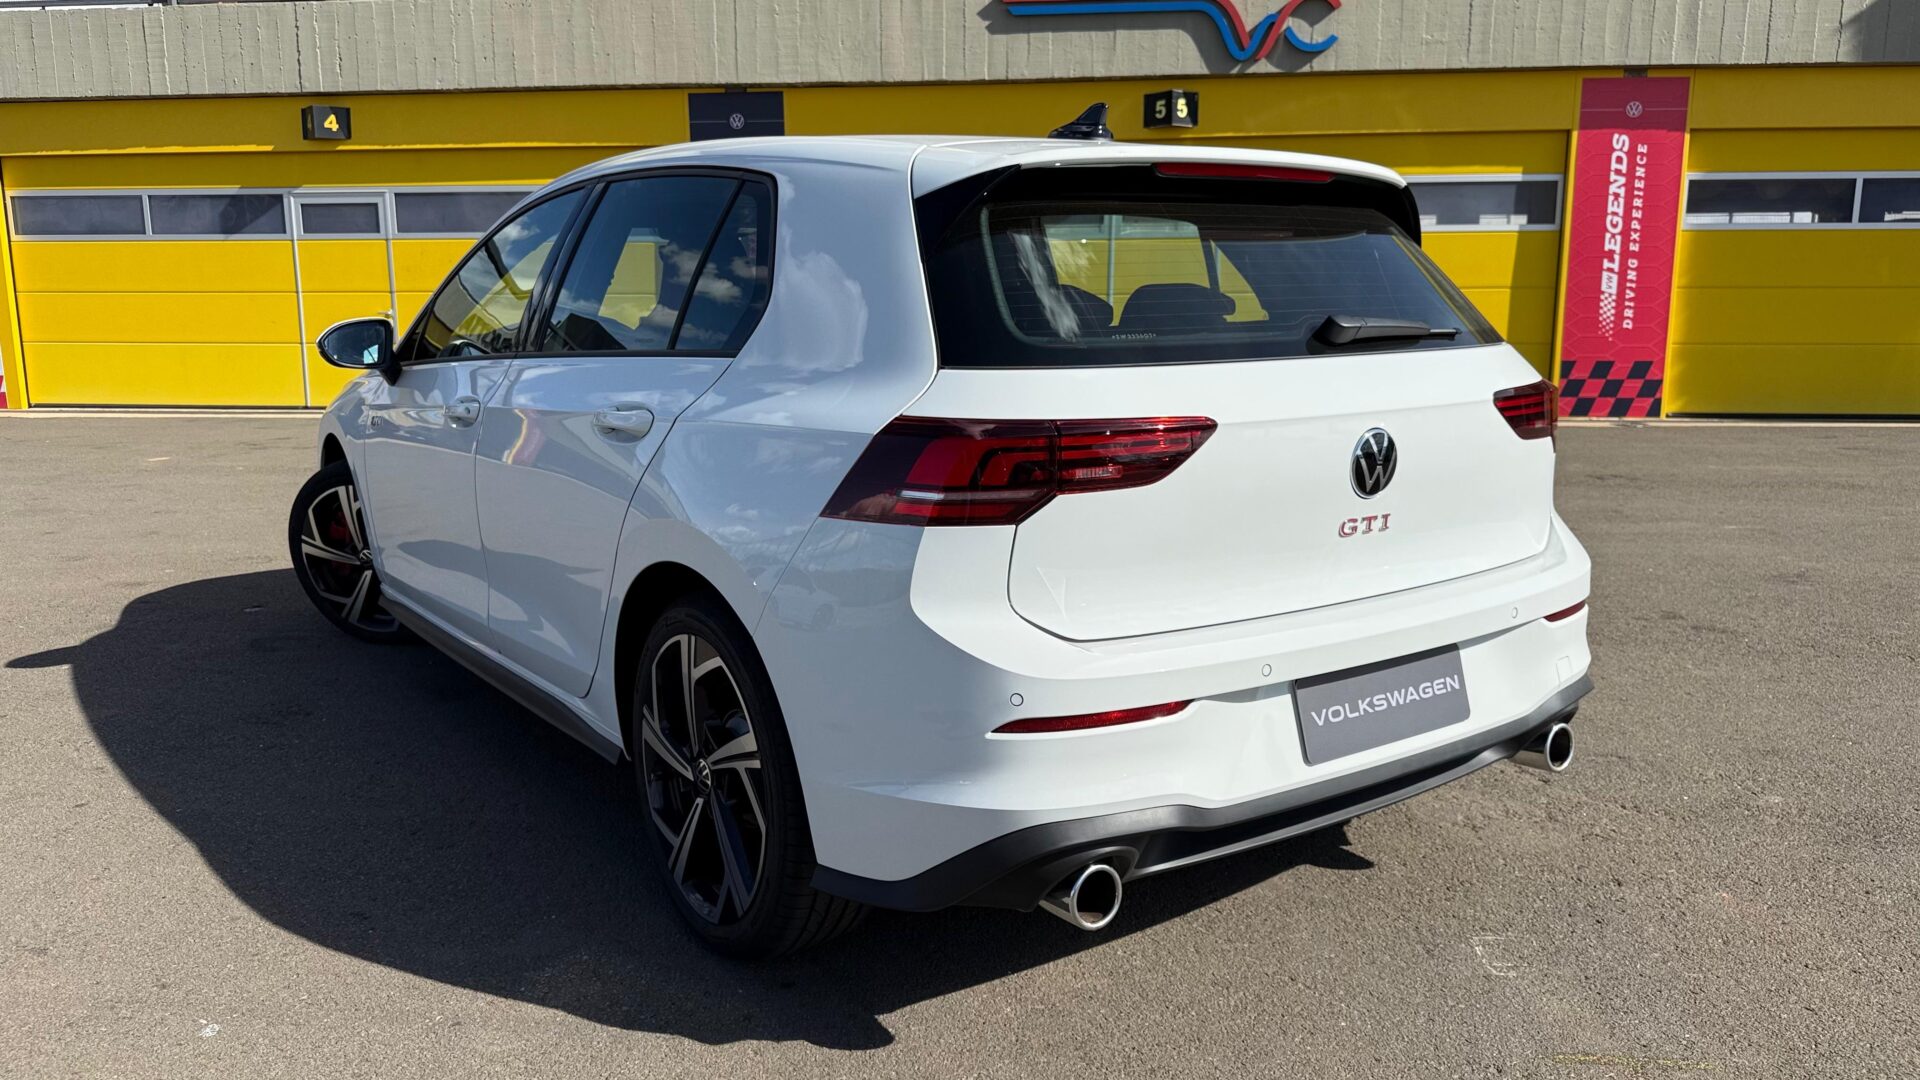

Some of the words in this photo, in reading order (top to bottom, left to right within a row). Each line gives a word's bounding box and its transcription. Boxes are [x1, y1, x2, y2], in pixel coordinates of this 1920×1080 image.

[323, 113, 339, 132] 4
[1155, 99, 1167, 119] 5
[1176, 97, 1188, 119] 5
[1602, 132, 1630, 273] LEGENDS
[1629, 143, 1648, 253] EXPERIENCE
[1622, 258, 1639, 330] DRIVING
[1338, 513, 1391, 538] GTI
[1311, 674, 1461, 726] VOLKSWAGEN
